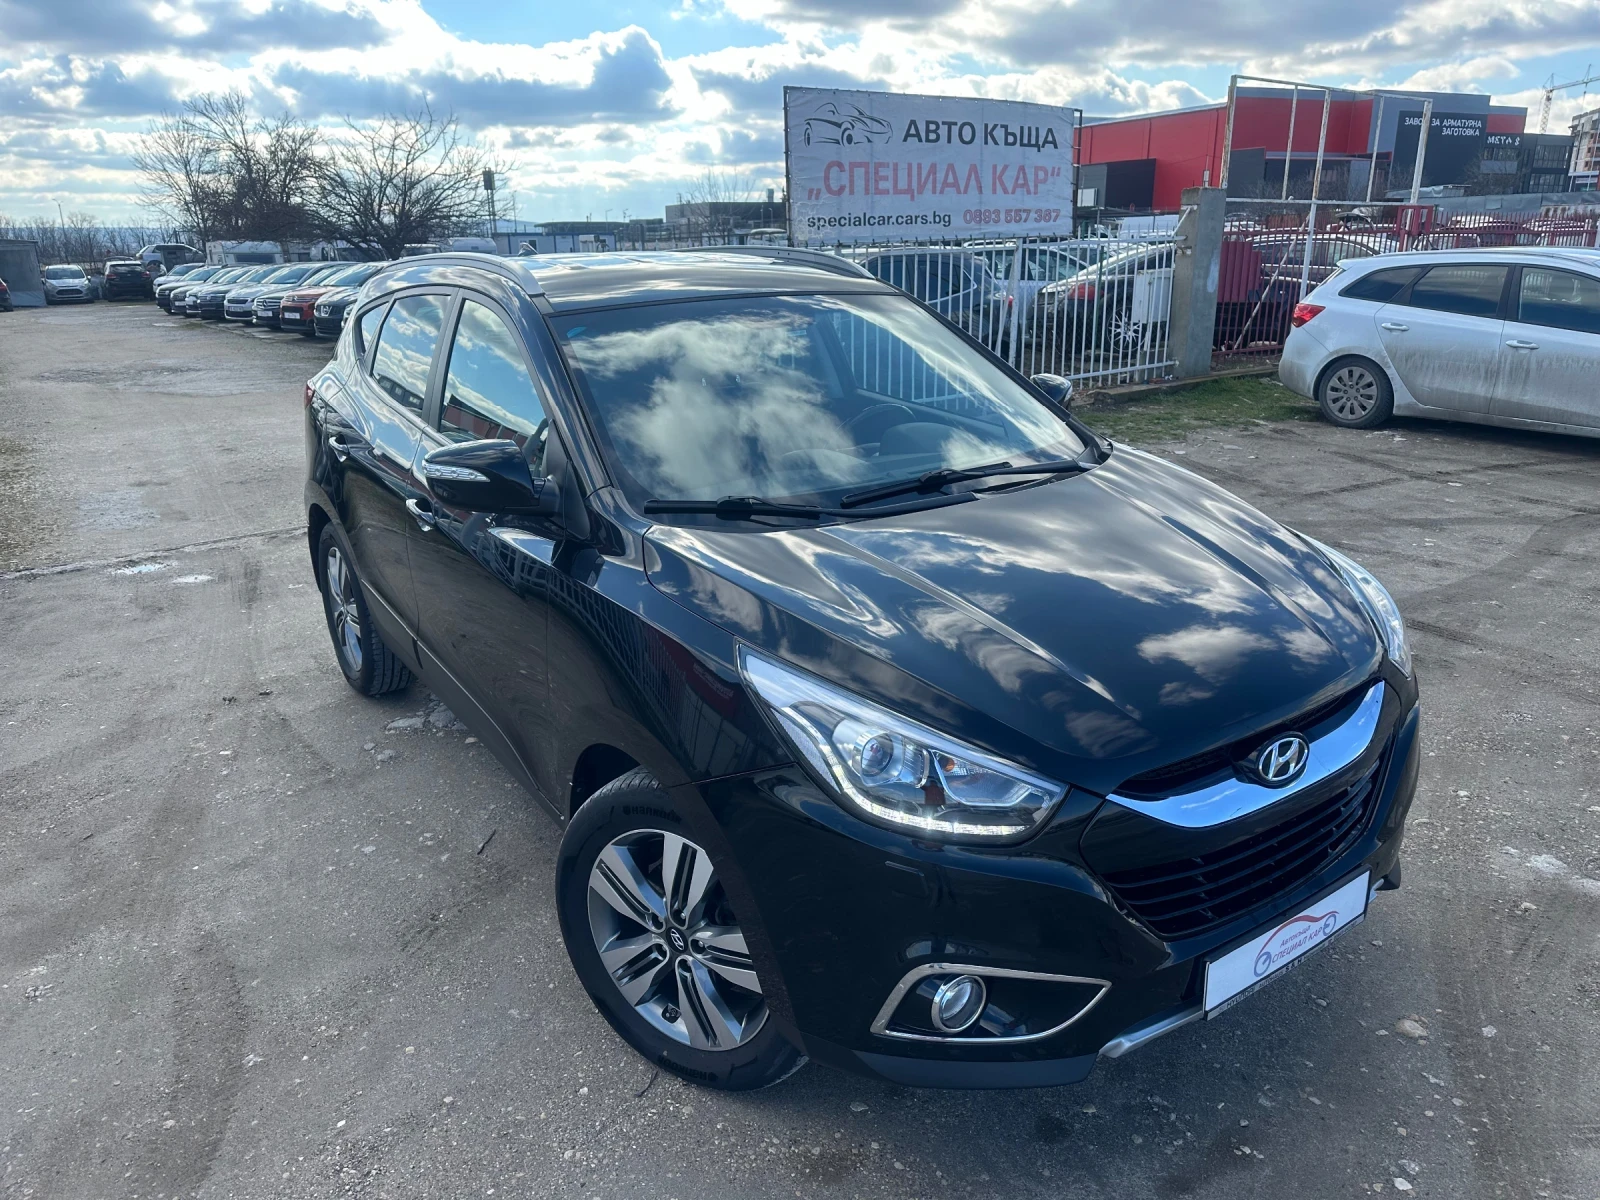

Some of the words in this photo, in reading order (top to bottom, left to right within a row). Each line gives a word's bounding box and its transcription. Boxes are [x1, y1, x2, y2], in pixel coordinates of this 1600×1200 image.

[1404, 117, 1423, 126] ЗАВО
[1431, 118, 1441, 126] ЗА
[1442, 118, 1482, 128] АРМАТУРНА
[1441, 127, 1480, 136] ЗАГОТОВКА
[902, 119, 976, 145] АВТО
[984, 123, 1058, 152] КЪЩА
[807, 160, 983, 201] „СПЕЦИАЛ
[807, 211, 952, 230] specialcar.cars.bg
[963, 208, 1001, 225] 0893
[1004, 208, 1033, 224] 557
[1307, 926, 1323, 944] КАР
